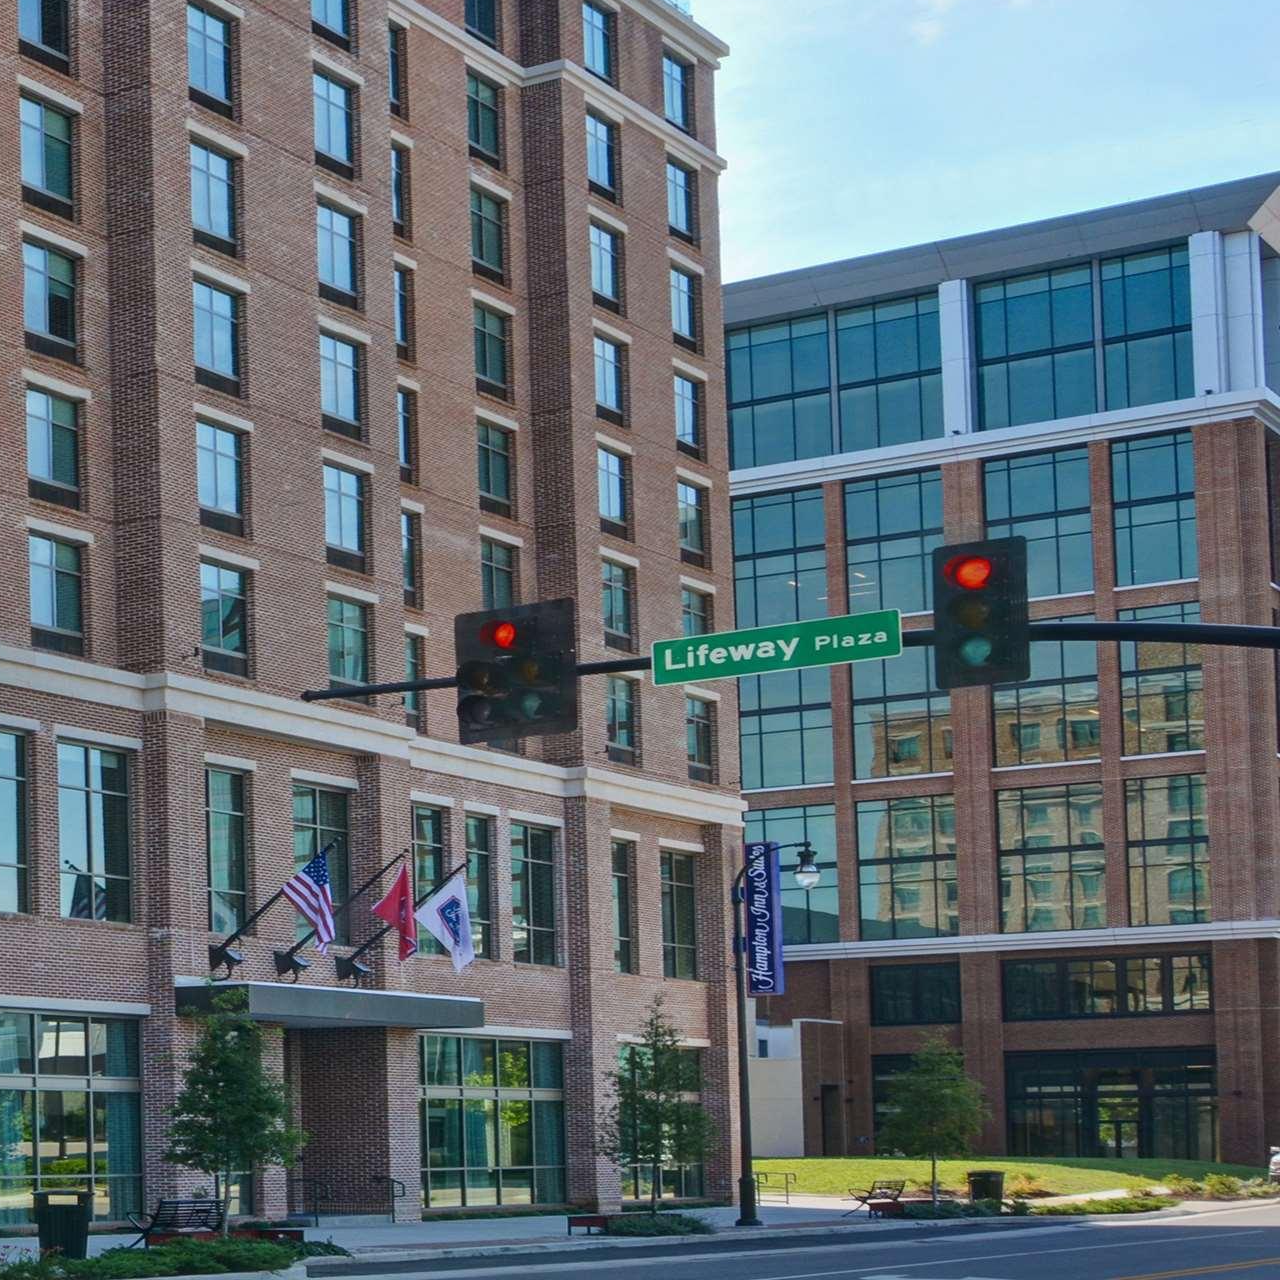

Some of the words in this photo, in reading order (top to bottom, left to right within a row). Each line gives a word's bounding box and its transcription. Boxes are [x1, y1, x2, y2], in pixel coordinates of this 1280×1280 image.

[664, 637, 800, 671] Lifeway
[814, 630, 888, 651] Plaza
[750, 888, 770, 922] Inn
[747, 922, 774, 990] Hampton
